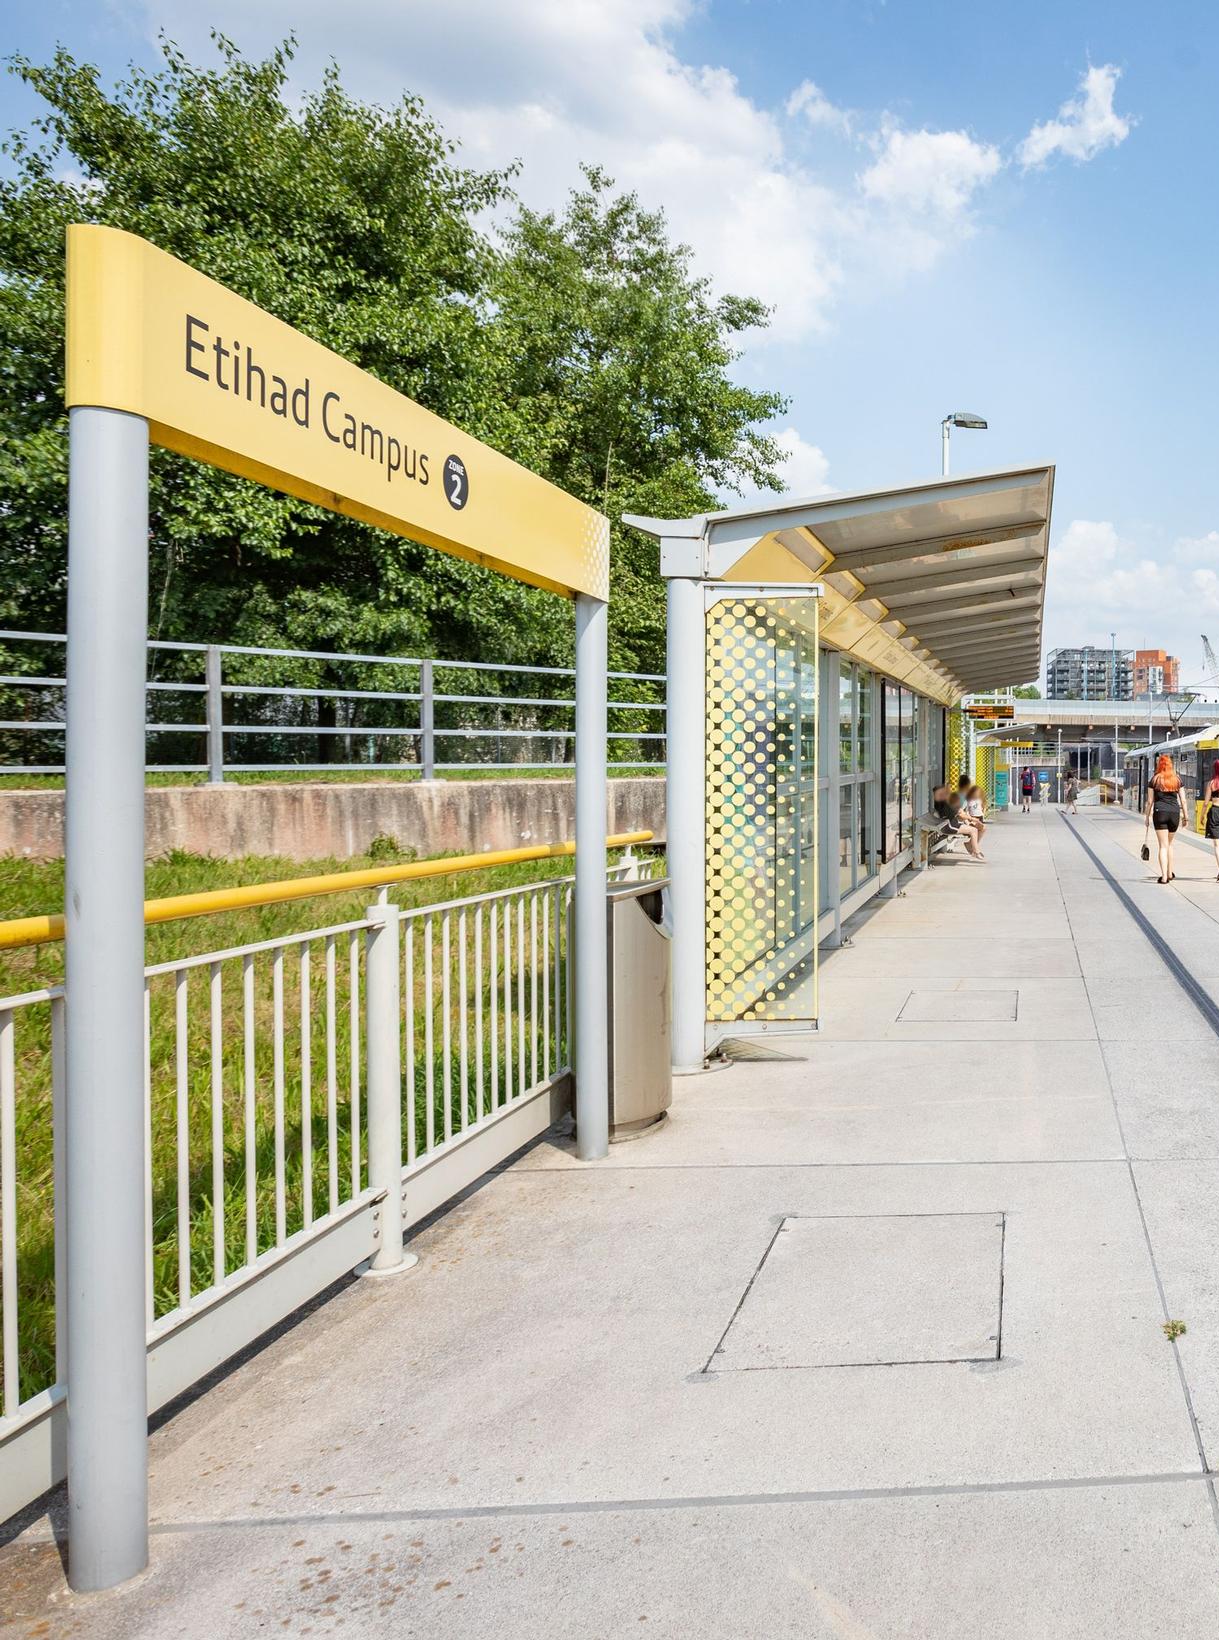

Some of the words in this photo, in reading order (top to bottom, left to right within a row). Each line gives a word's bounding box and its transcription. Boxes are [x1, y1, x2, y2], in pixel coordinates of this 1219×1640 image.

[186, 314, 310, 429] Etihad
[322, 391, 430, 486] Campus
[448, 459, 465, 476] ZONE
[451, 474, 462, 506] 2
